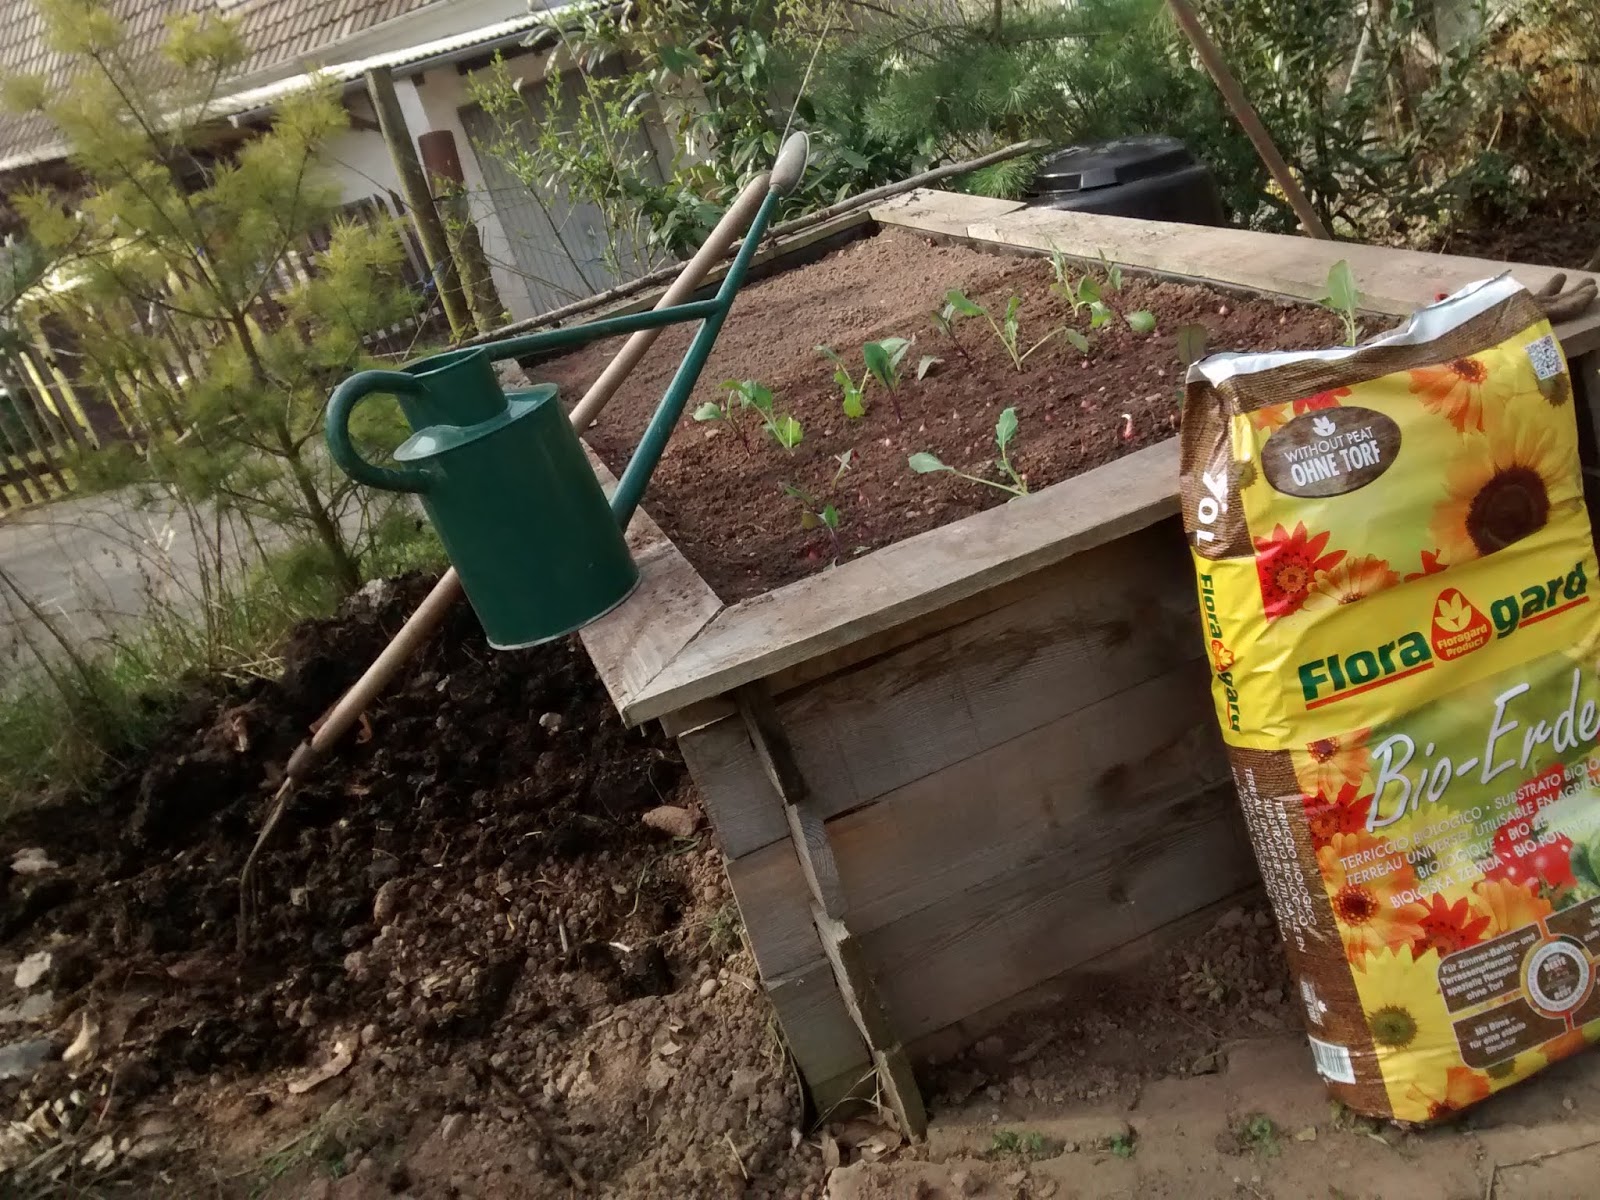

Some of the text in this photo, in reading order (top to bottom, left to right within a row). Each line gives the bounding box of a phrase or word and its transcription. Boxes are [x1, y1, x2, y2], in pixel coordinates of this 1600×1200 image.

[1284, 426, 1374, 462] WITHOUT PEAT
[1291, 440, 1380, 486] OHNE TORF
[1200, 574, 1223, 639] Flora
[1216, 671, 1241, 732] gard
[1298, 631, 1433, 701] Flora
[1490, 561, 1588, 639] gard
[1437, 624, 1487, 649] Floragard
[1446, 636, 1483, 657] Product
[1366, 668, 1600, 832] Bio-Erde
[1244, 767, 1263, 815] TERREAU
[1259, 817, 1282, 875] UNIVERSEL
[1296, 936, 1307, 953] EN
[1264, 797, 1308, 926] SUBSTRATO BIOLOGICO
[1275, 801, 1317, 926] TERRICCIO BIOLOGICO
[1340, 760, 1600, 871] TERRICCIO BIOLOGICO SUBSTRATO BIOLO
[1346, 856, 1403, 887] TERREAU
[1406, 831, 1472, 865] UNIVERSEL
[1475, 802, 1535, 836] UTILISABLE
[1536, 793, 1554, 811] EN
[1418, 837, 1497, 879] BIOLOGIQUE
[1508, 822, 1530, 841] BIO
[1513, 840, 1537, 858] BIO
